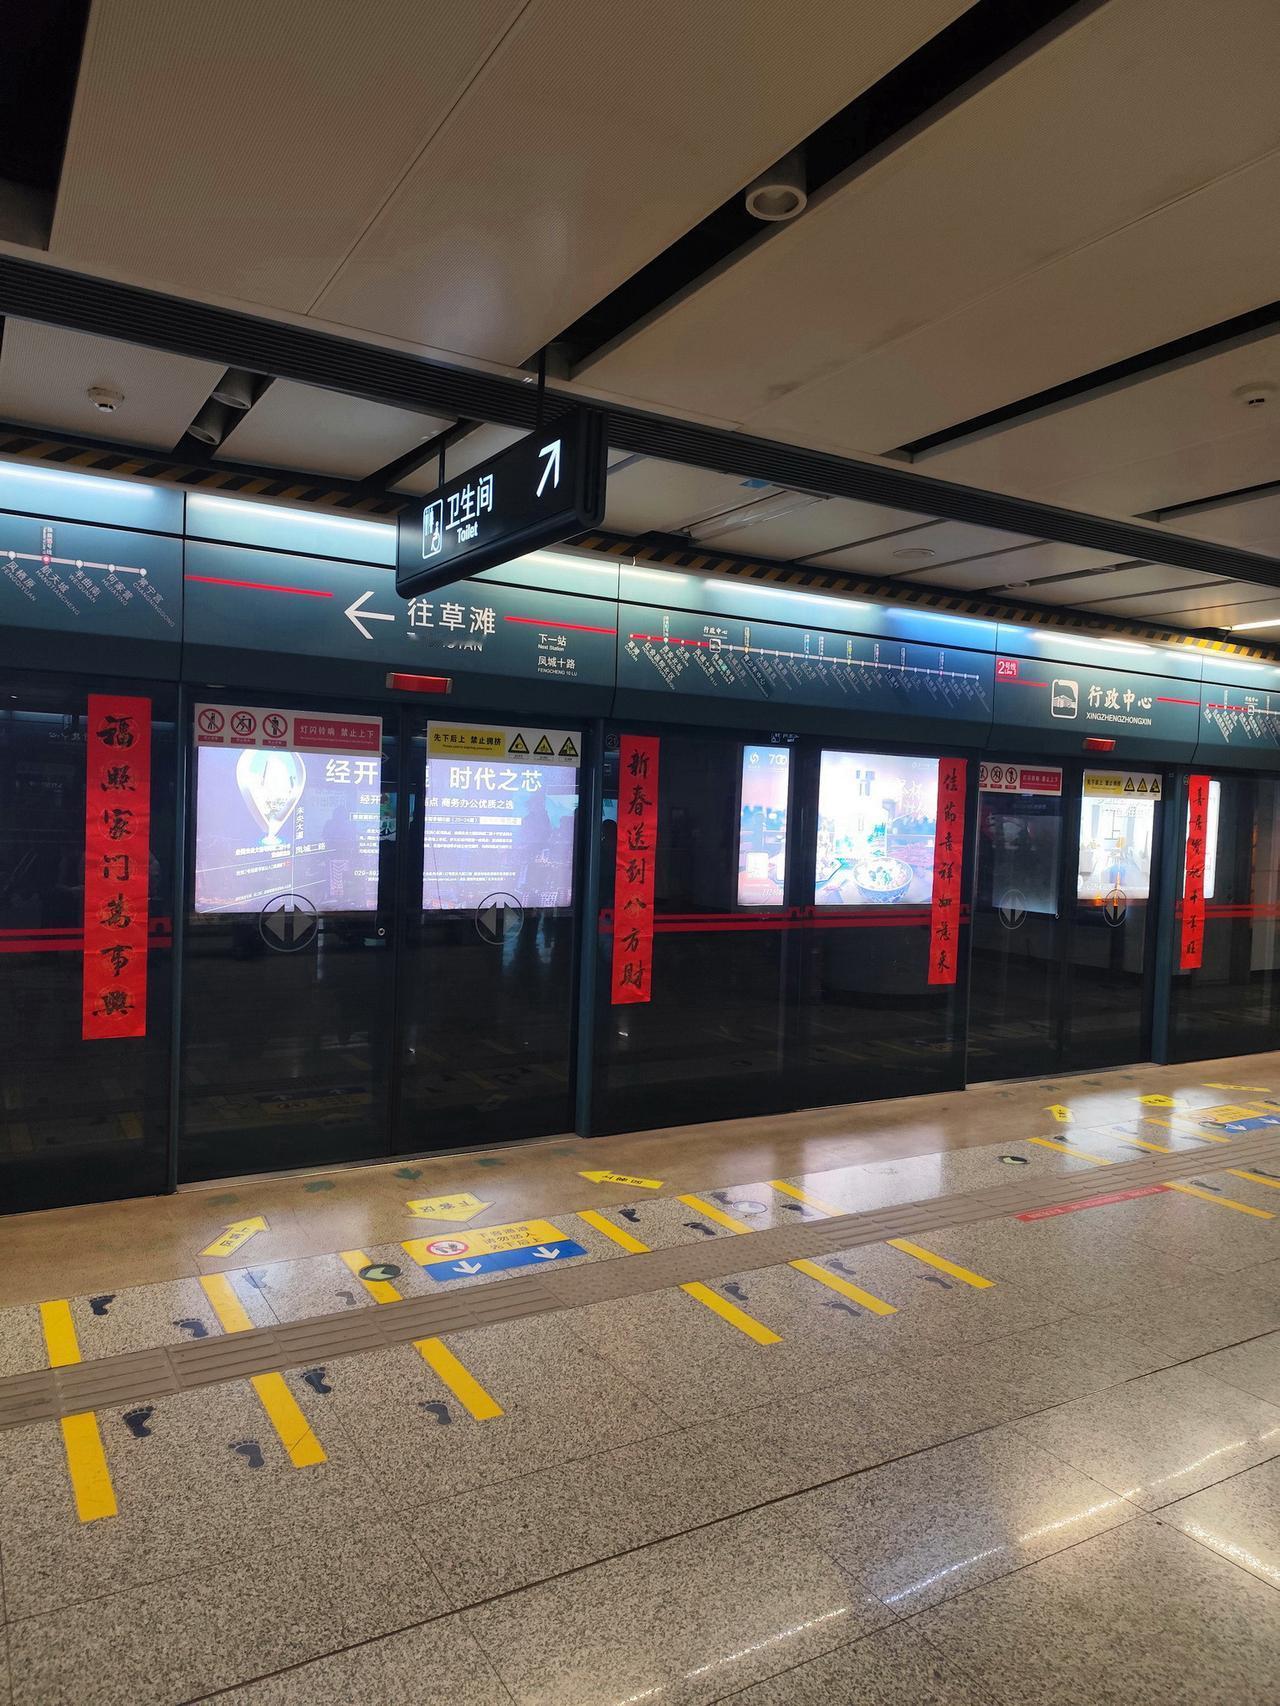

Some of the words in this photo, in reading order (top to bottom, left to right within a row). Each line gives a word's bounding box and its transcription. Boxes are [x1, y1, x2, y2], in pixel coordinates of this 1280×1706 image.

[445, 473, 493, 531] 卫生间
[456, 521, 478, 543] Toilet
[407, 597, 496, 635] 往草滩
[538, 633, 567, 647] 下一站
[537, 655, 575, 669] 凤城十路
[1087, 685, 1153, 712] 行政中心
[1086, 711, 1152, 726] XINGZHENGZHONGXIN
[340, 727, 375, 739] 禁止上下
[433, 733, 466, 744] 先下后上
[325, 758, 378, 785] 经开
[449, 766, 543, 793] 时代之芯
